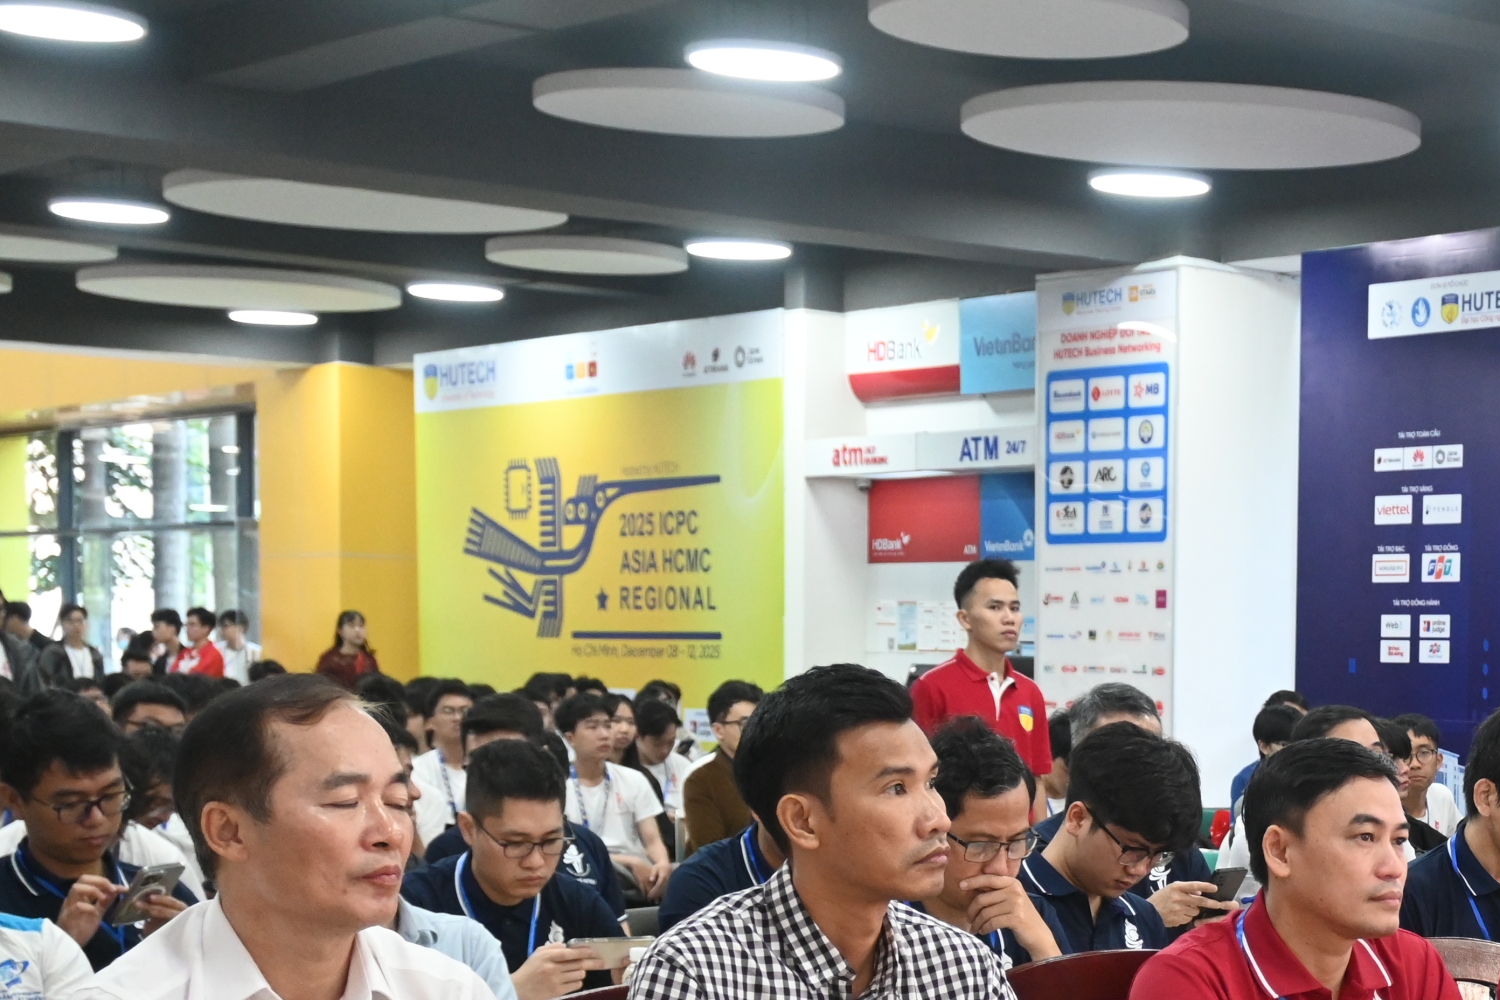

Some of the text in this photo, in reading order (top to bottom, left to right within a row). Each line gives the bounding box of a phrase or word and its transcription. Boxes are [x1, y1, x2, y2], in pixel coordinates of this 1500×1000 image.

[1076, 288, 1122, 306] HUTECH
[867, 338, 923, 362] HDBank
[973, 332, 1035, 356] VietinBa
[1054, 342, 1161, 359] HUTECH Business Networking
[440, 360, 496, 387] HUTECH
[1146, 383, 1159, 395] MB
[832, 444, 864, 467] atm
[960, 436, 1026, 461] ATM 24/7
[1377, 505, 1410, 515] viettel
[619, 510, 698, 536] 2025 ICPC
[872, 538, 902, 549] HDBank
[964, 544, 977, 554] ATM
[985, 540, 1024, 552] VietinBank
[620, 548, 711, 573] ASIA HCMC
[1427, 555, 1452, 579] FPT
[619, 586, 716, 611] REGIONAL
